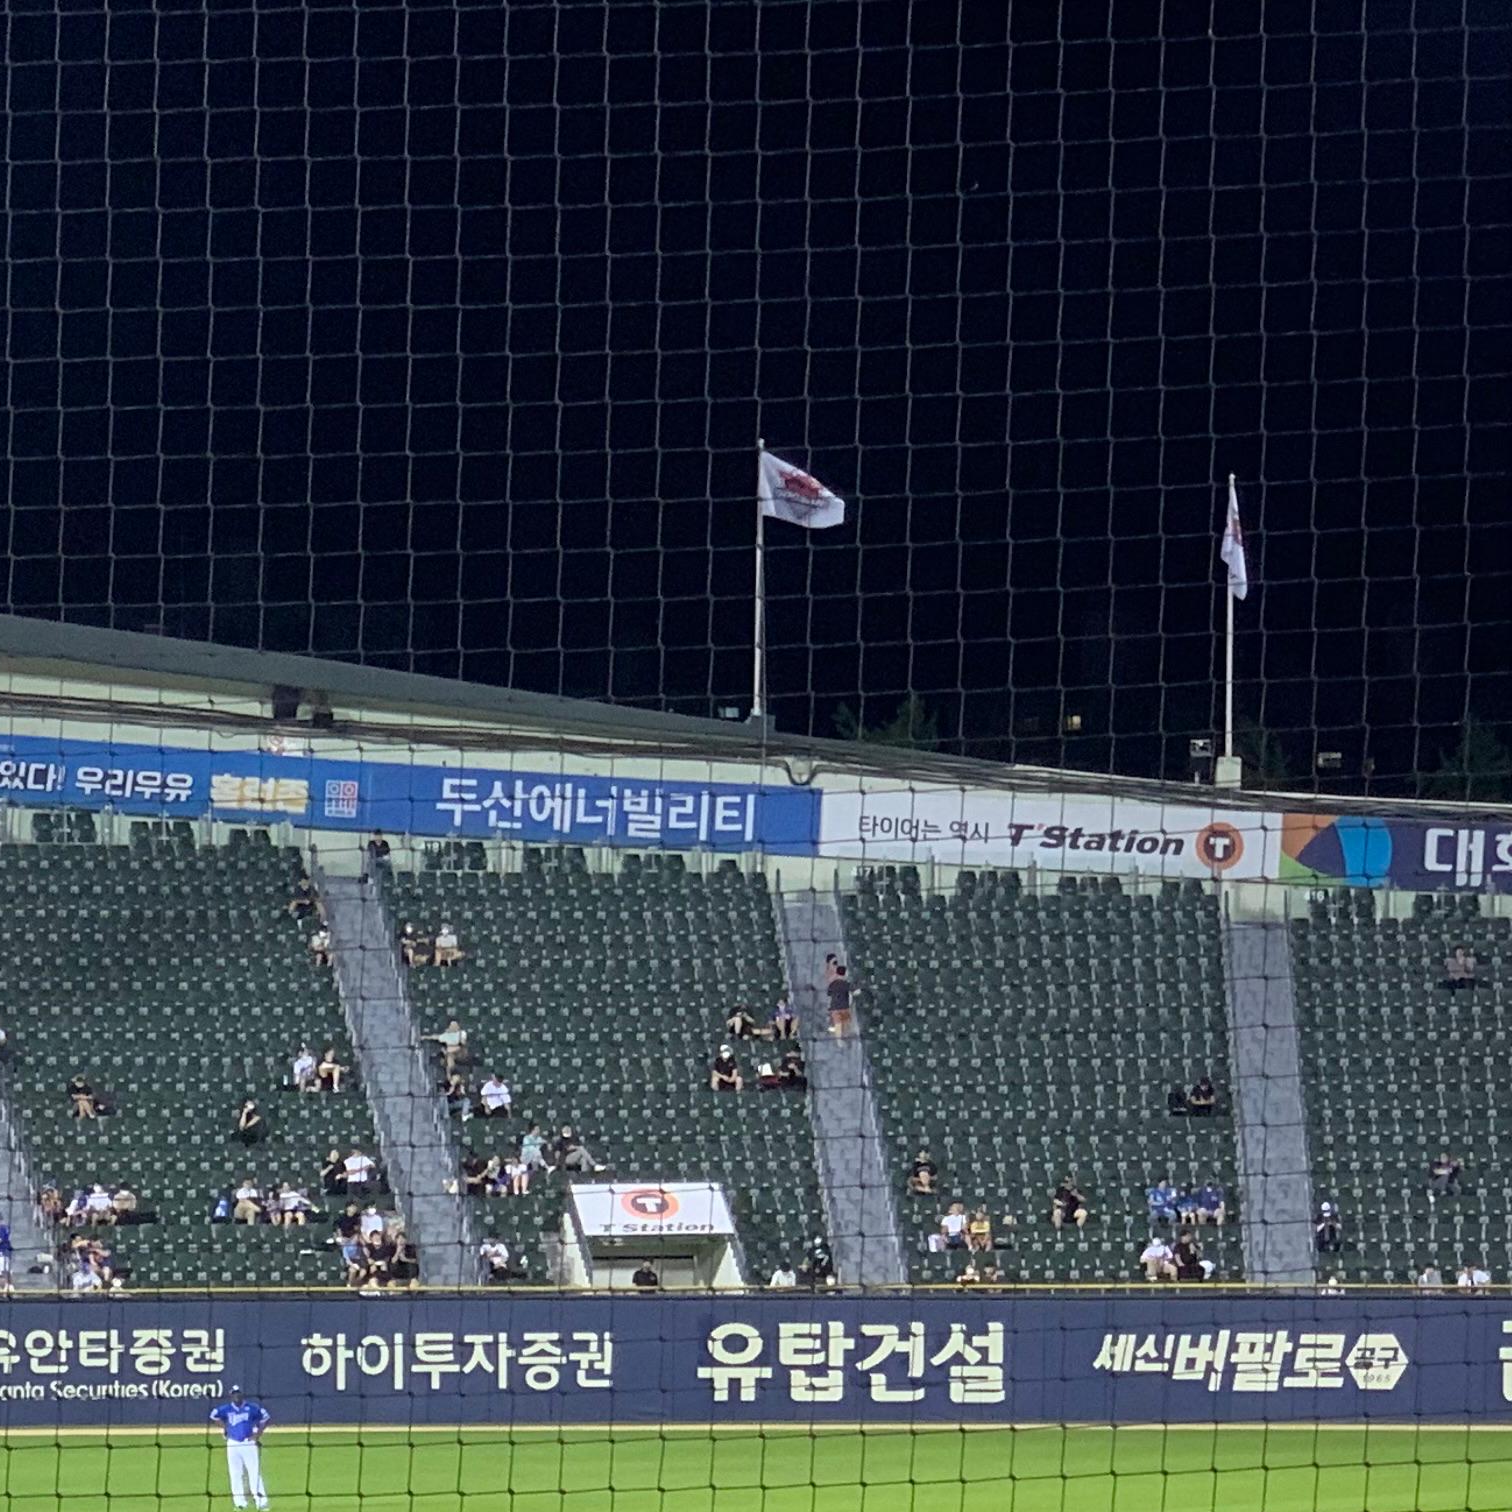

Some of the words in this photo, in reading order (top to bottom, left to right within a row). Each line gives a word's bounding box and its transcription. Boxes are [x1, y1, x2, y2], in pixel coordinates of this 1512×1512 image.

[76, 767, 194, 801] 우리우유
[436, 778, 755, 842] 두산에너빌리티
[858, 815, 942, 841] 타이어는
[949, 821, 989, 844] 역시
[50, 1380, 148, 1400] Securities
[152, 1379, 224, 1399] (Korea)
[300, 1331, 614, 1391] 하이투자증권
[697, 1321, 1006, 1404] 유탑건설
[1093, 1329, 1345, 1392] 세신버팔로
